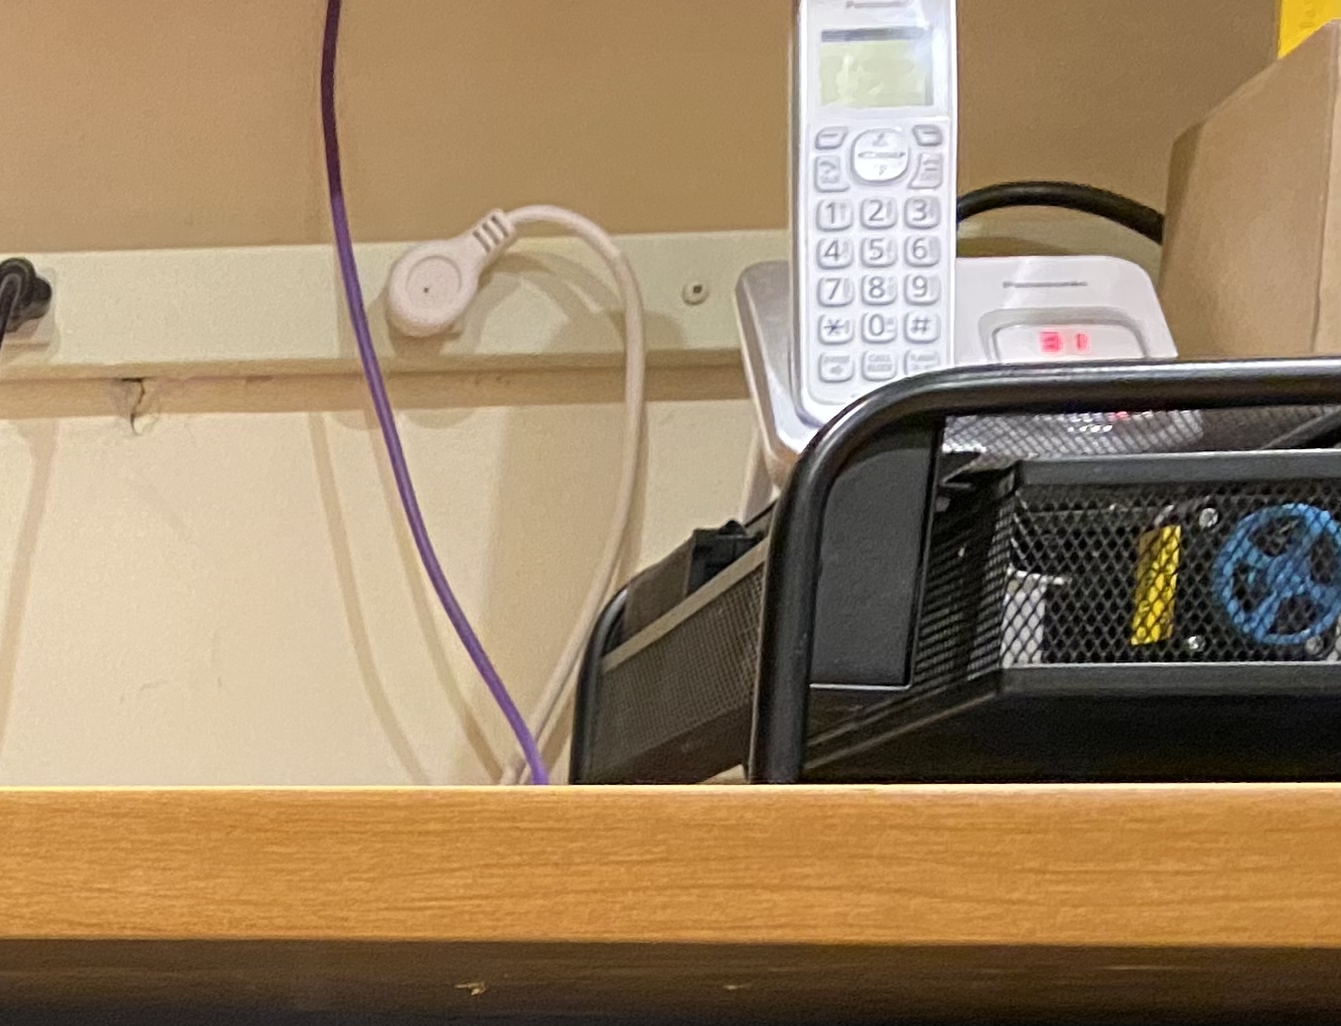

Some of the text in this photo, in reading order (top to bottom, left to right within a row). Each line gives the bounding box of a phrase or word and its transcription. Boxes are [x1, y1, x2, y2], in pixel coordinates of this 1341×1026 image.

[826, 202, 836, 224] 1
[869, 199, 885, 222] 2
[912, 199, 928, 222] 3
[824, 239, 840, 261] 4
[869, 237, 884, 261] 5
[912, 236, 928, 260] 6
[825, 278, 842, 300] 7
[869, 275, 885, 299] 8
[912, 274, 928, 298] 9
